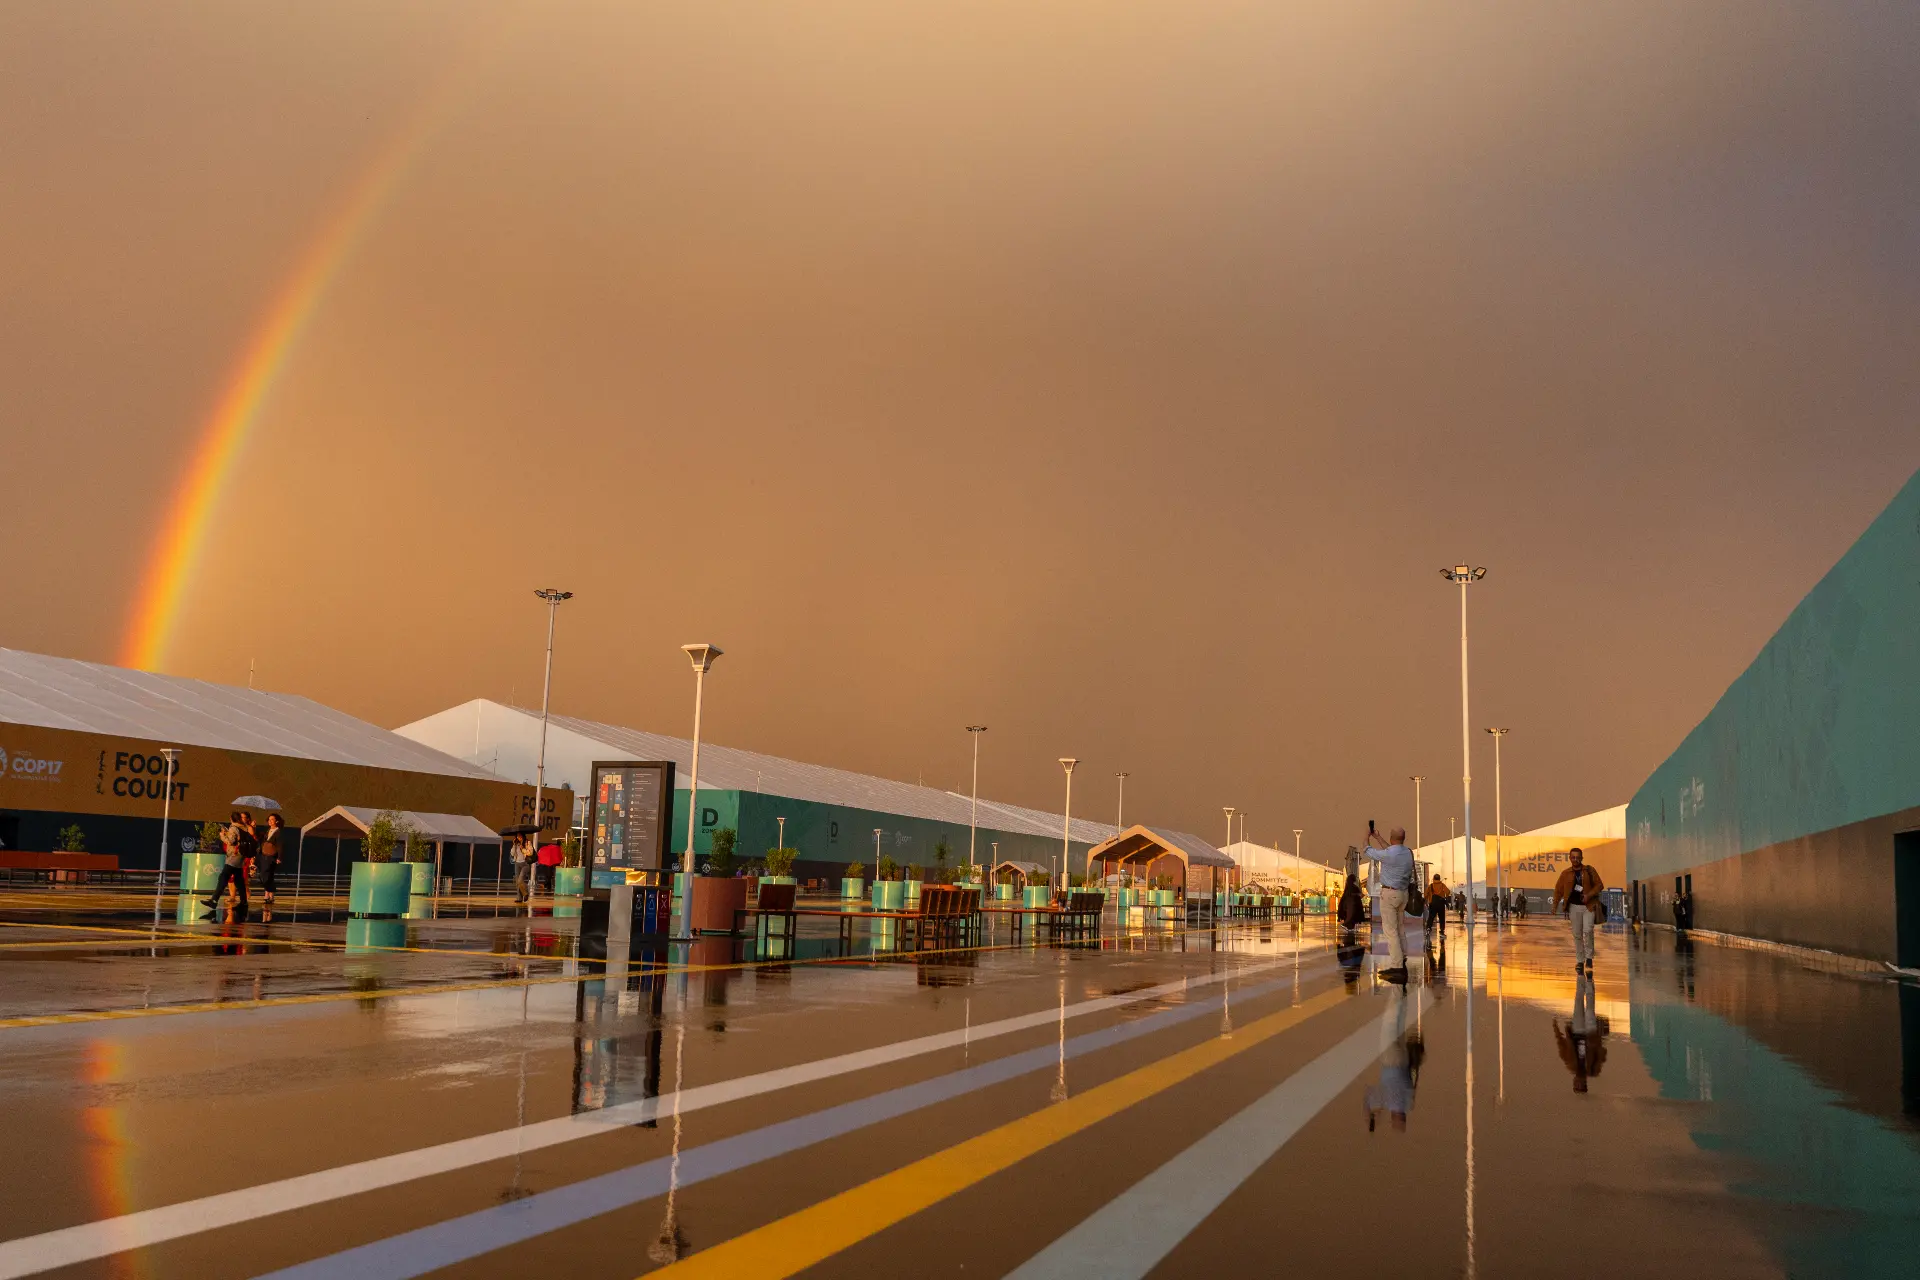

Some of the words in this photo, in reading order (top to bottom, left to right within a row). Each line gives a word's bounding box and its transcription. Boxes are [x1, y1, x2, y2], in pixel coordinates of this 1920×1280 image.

[12, 757, 63, 775] COP17
[115, 752, 179, 776] FOOD
[113, 776, 189, 801] COURT
[522, 796, 555, 812] FOOD
[702, 808, 718, 826] D
[1518, 862, 1556, 872] AREA
